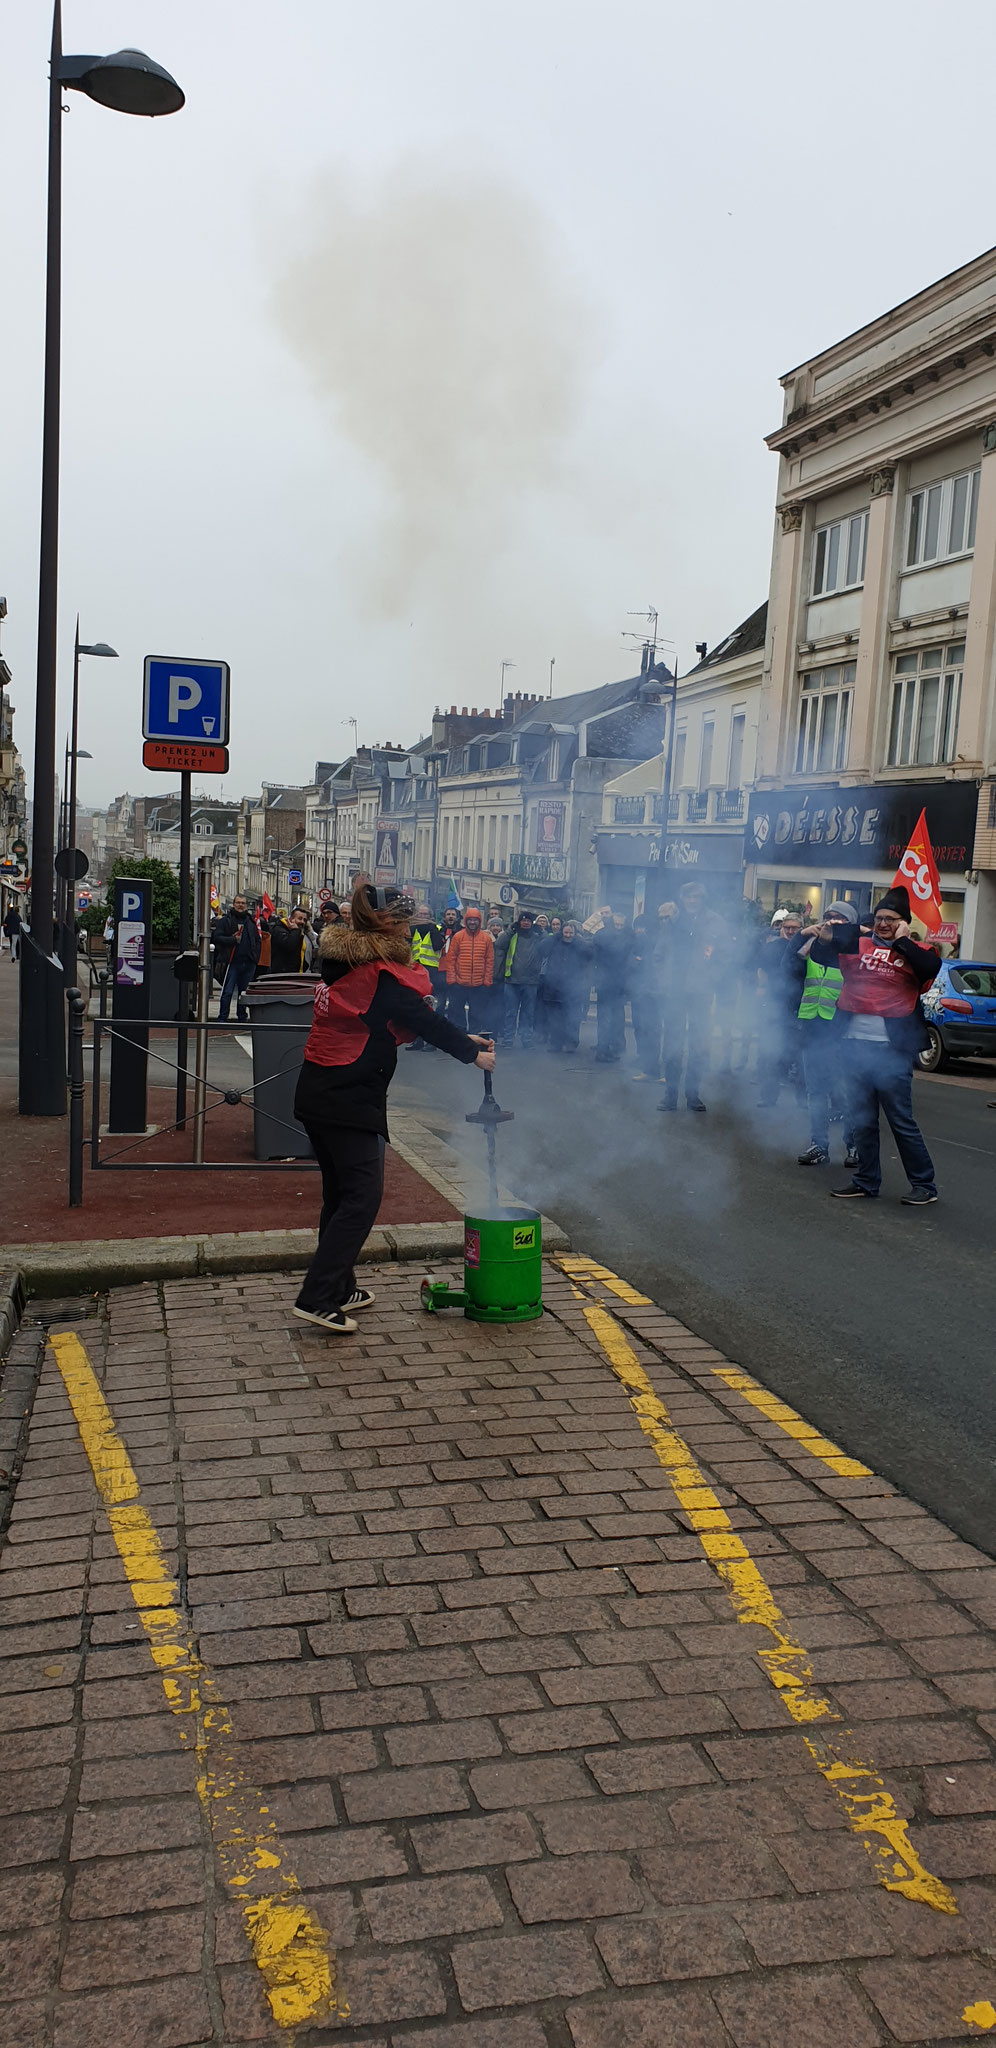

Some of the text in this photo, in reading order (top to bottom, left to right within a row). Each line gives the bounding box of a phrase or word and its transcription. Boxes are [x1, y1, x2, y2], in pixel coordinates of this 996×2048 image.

[168, 675, 203, 724] P
[155, 745, 216, 758] PRENEZ UN
[167, 756, 204, 767] TICKET
[774, 795, 880, 845] DÉESSE
[122, 893, 141, 919] P
[515, 1229, 534, 1245] Sud
